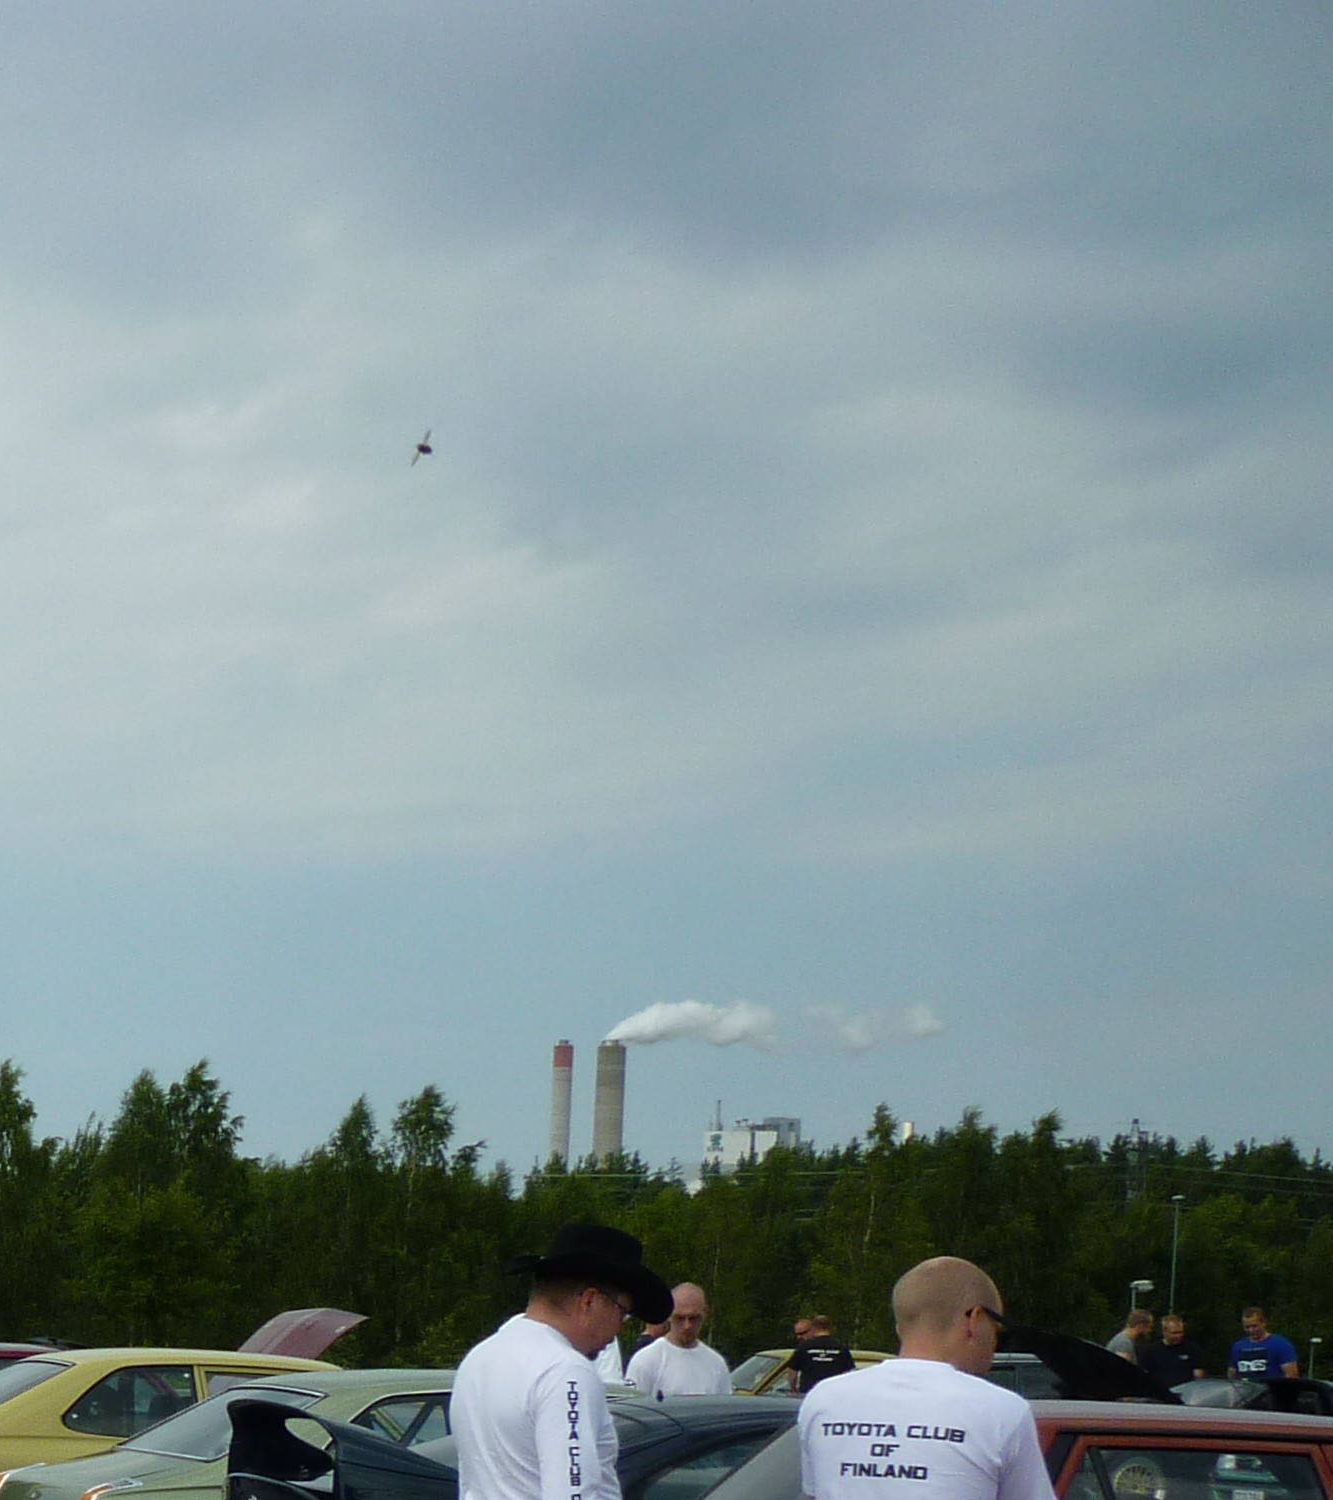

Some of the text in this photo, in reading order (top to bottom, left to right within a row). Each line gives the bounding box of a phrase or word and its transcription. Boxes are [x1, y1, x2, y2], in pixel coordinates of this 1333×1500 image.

[567, 1381, 579, 1440] TOYOTA
[822, 1422, 966, 1443] TOYOTA CLUB
[870, 1443, 900, 1457] OF
[568, 1446, 581, 1486] CLUB
[840, 1462, 928, 1480] FINLAND
